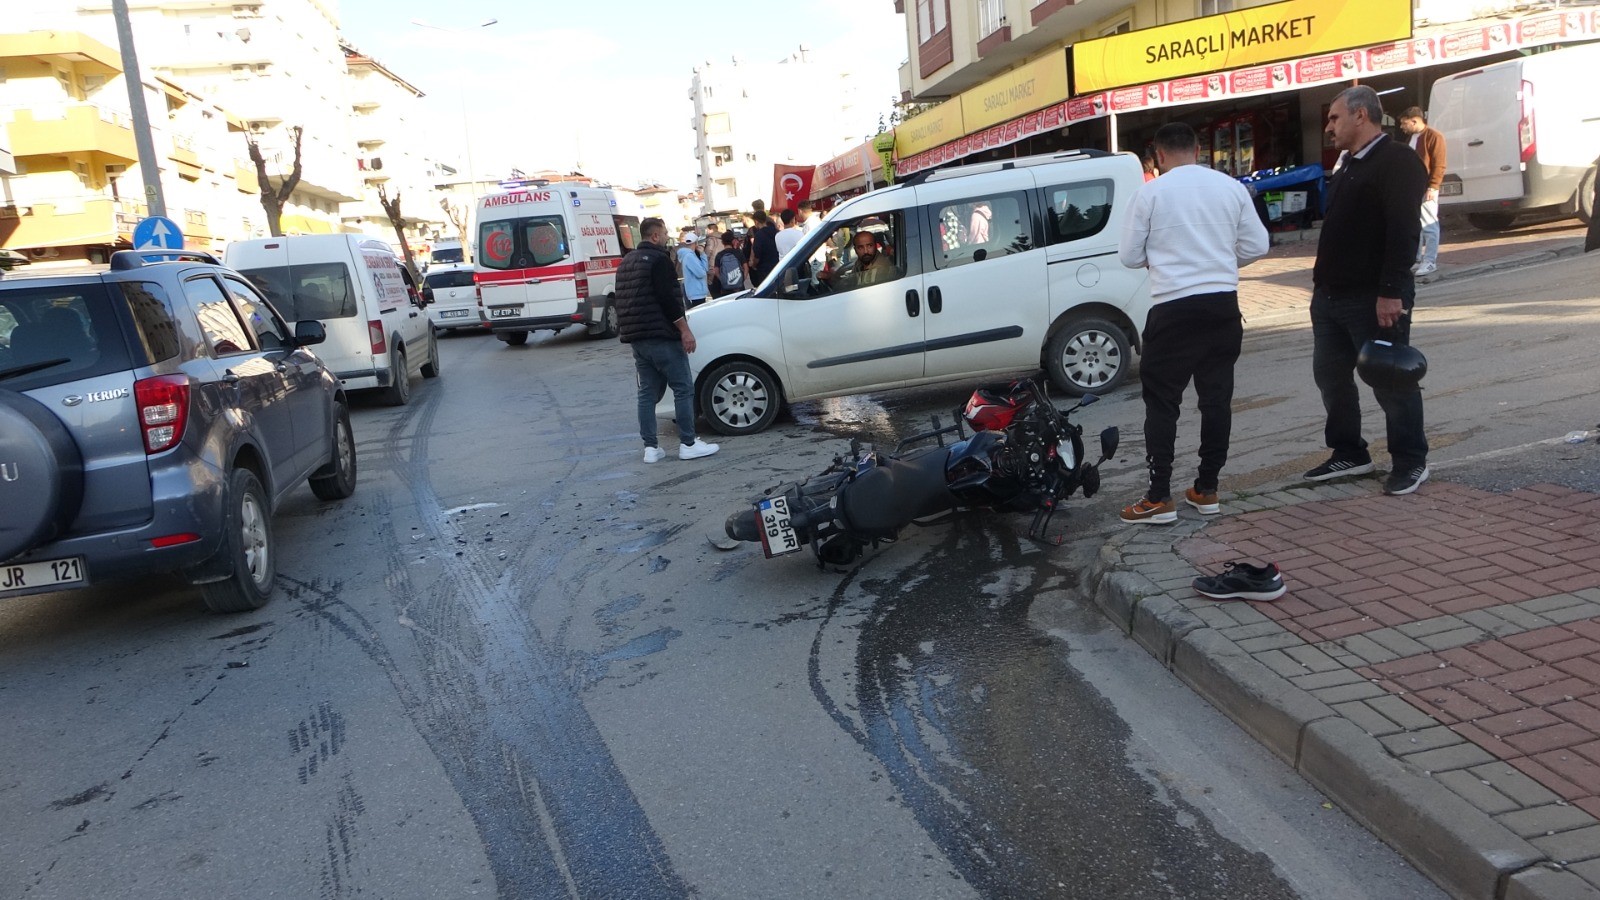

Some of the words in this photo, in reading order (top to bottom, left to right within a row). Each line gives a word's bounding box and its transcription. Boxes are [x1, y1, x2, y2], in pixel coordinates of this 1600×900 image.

[1146, 33, 1224, 63] SARAÇLI
[1231, 15, 1316, 49] MARKET
[983, 89, 1008, 112] SARAÇLI
[1008, 78, 1036, 104] MARKET
[484, 191, 551, 208] AMBULANS
[581, 226, 595, 236] SAĞLIK
[493, 238, 512, 252] 112
[596, 239, 608, 254] 112
[586, 259, 613, 270] AMBULANS
[86, 387, 129, 403] TERIOS
[774, 499, 787, 515] 07
[765, 514, 779, 537] 319
[779, 518, 796, 549] BHR
[3, 567, 26, 587] JR
[51, 559, 80, 581] 121
